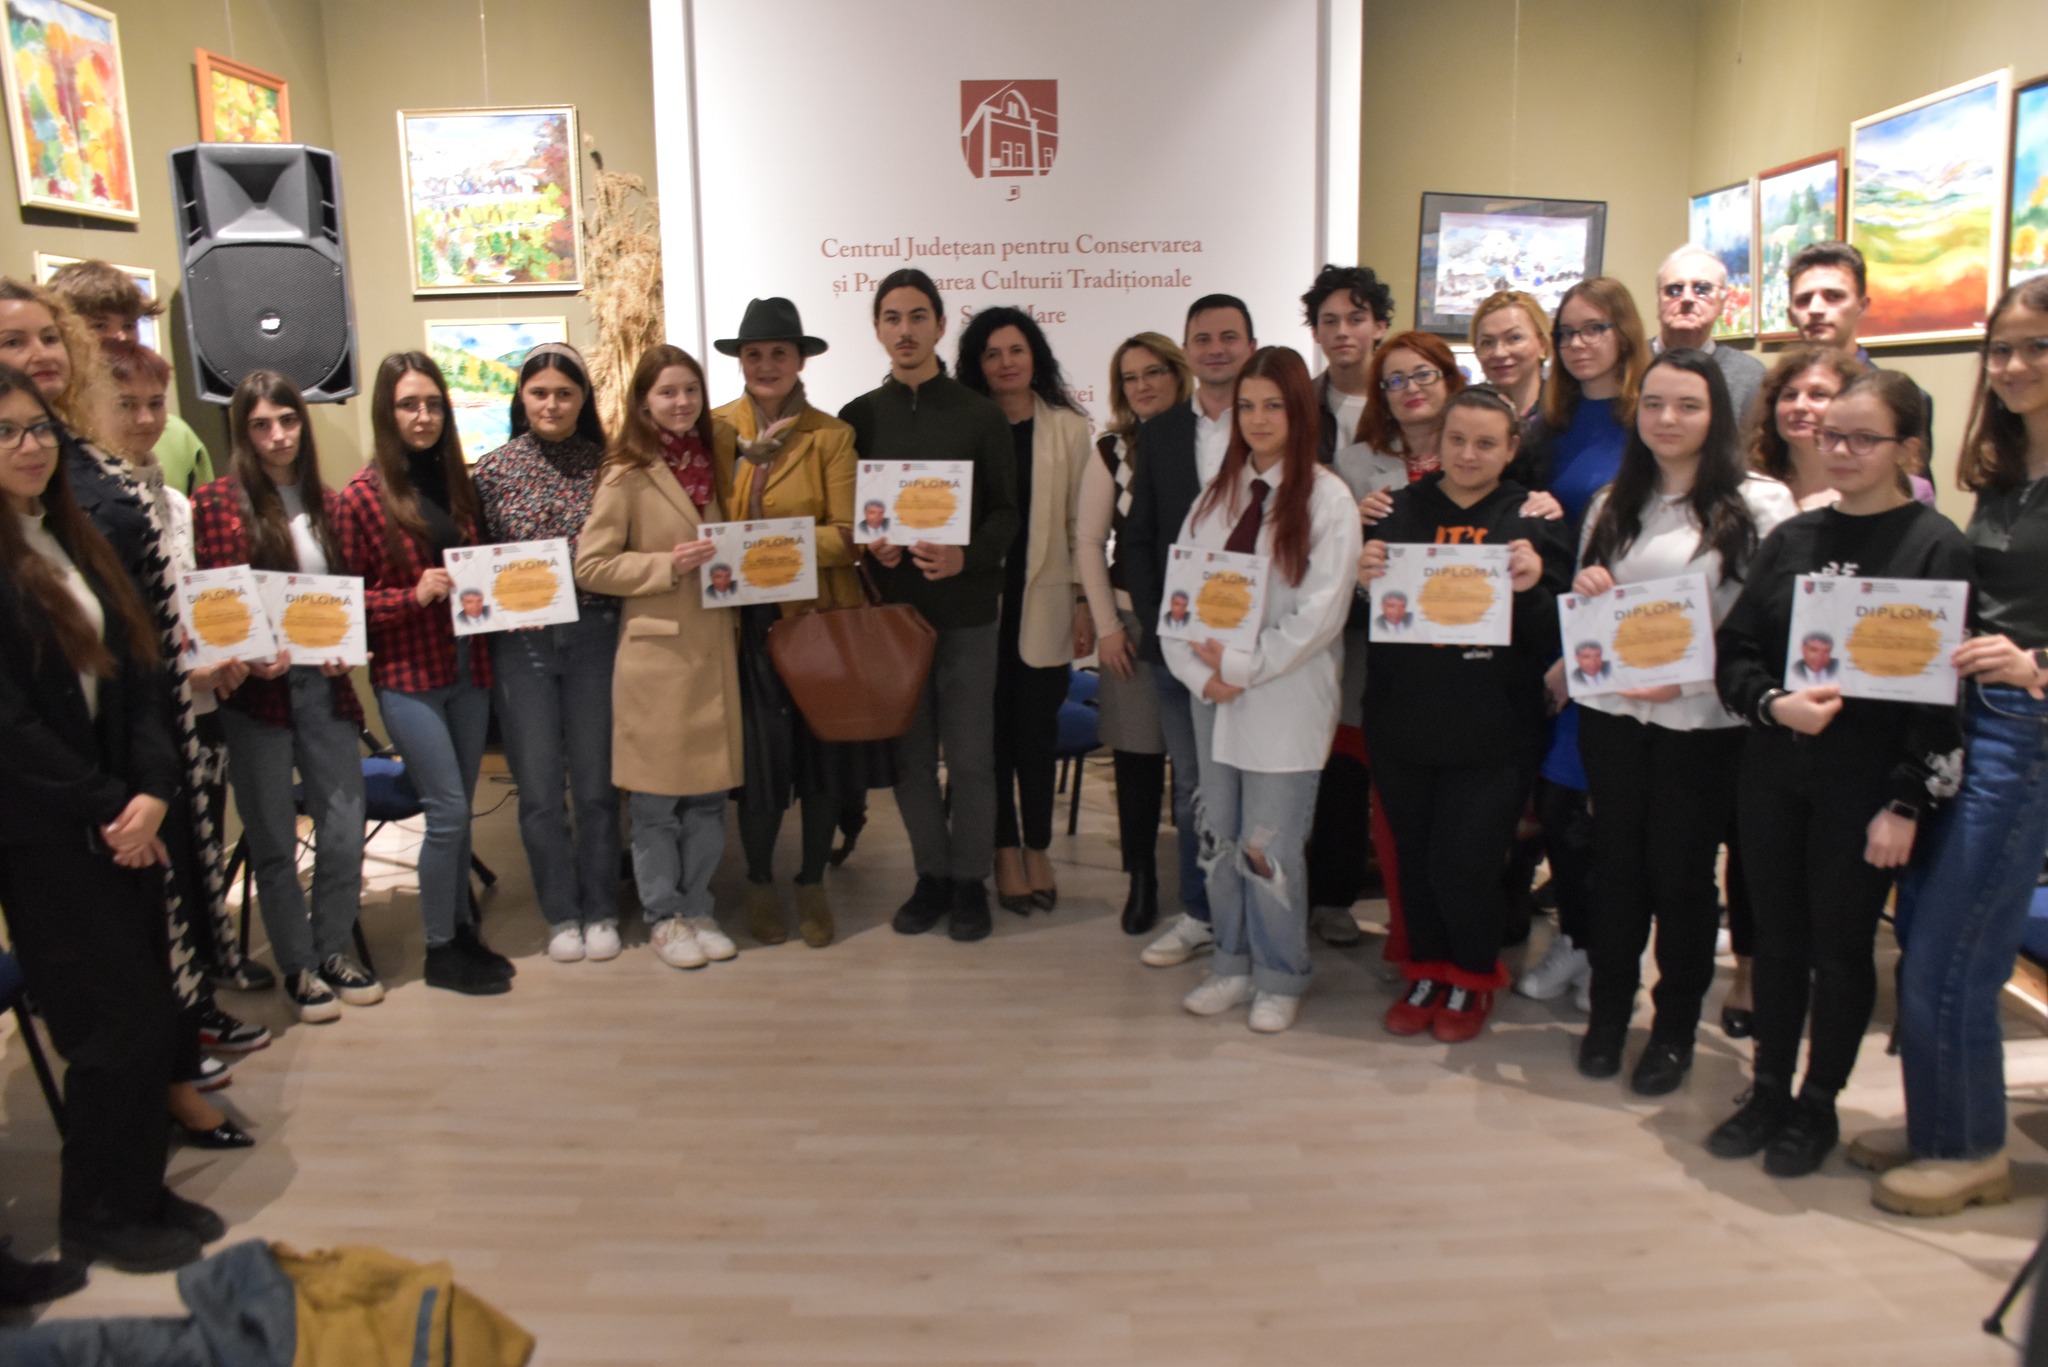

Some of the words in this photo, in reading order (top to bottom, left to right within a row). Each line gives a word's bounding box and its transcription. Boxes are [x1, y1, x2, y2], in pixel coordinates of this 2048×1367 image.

[821, 237, 900, 258] Centrul
[904, 236, 996, 262] Județean
[1001, 240, 1070, 262] pentru
[1076, 234, 1203, 254] Conservarea
[832, 275, 848, 299] și
[982, 269, 1062, 290] Culturii
[1067, 268, 1192, 294] Tradiționale
